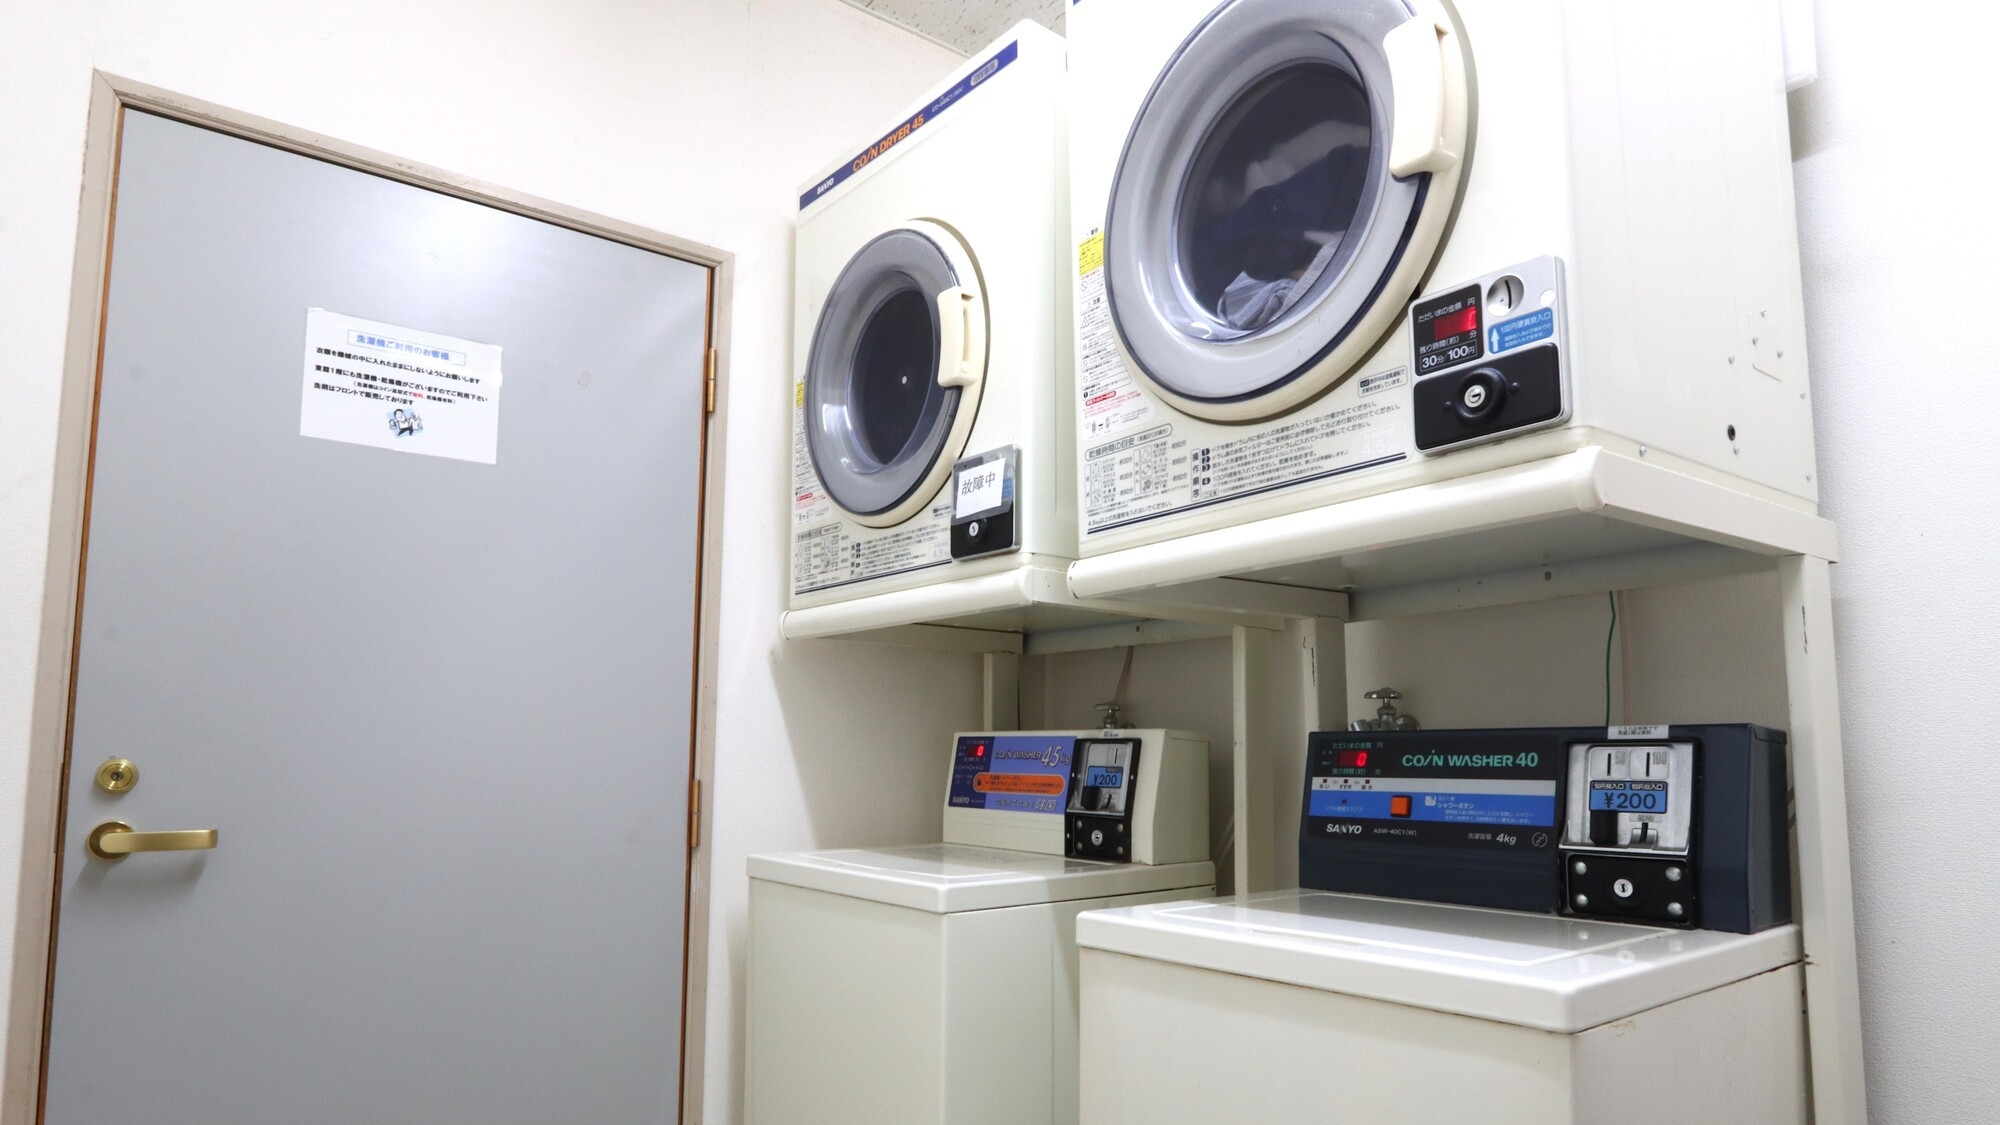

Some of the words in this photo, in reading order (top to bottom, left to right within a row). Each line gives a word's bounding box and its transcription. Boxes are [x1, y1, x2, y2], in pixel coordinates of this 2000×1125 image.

[879, 124, 910, 152] DRYER
[912, 113, 925, 130] 45
[1417, 303, 1463, 324] ただいまの金額
[1467, 297, 1476, 306] 円
[1469, 330, 1477, 339] 分
[356, 333, 450, 361] 洗濯機ご利用のお客様
[316, 347, 481, 384] 衣類を機械の中に入れたままにしないようにお願いします
[313, 382, 414, 406] 洗剤はフロントで販売しております
[1089, 437, 1135, 459] 乾燥時間の目安
[961, 472, 996, 496] 故障中
[976, 745, 985, 756] 0
[1376, 741, 1384, 750] 円
[1014, 750, 1042, 759] WASHER
[1356, 750, 1368, 767] 0
[1448, 755, 1514, 767] WASHER
[1515, 751, 1539, 767] 40
[1652, 750, 1667, 766] 100
[1093, 773, 1118, 786] ¥200
[1374, 768, 1381, 776] 分
[1631, 783, 1663, 791] 100円投入口
[1603, 792, 1656, 809] ¥200
[1326, 823, 1362, 834] SANYO
[1373, 828, 1417, 837] ASW-40C1(W)
[1496, 833, 1517, 845] 4kg
